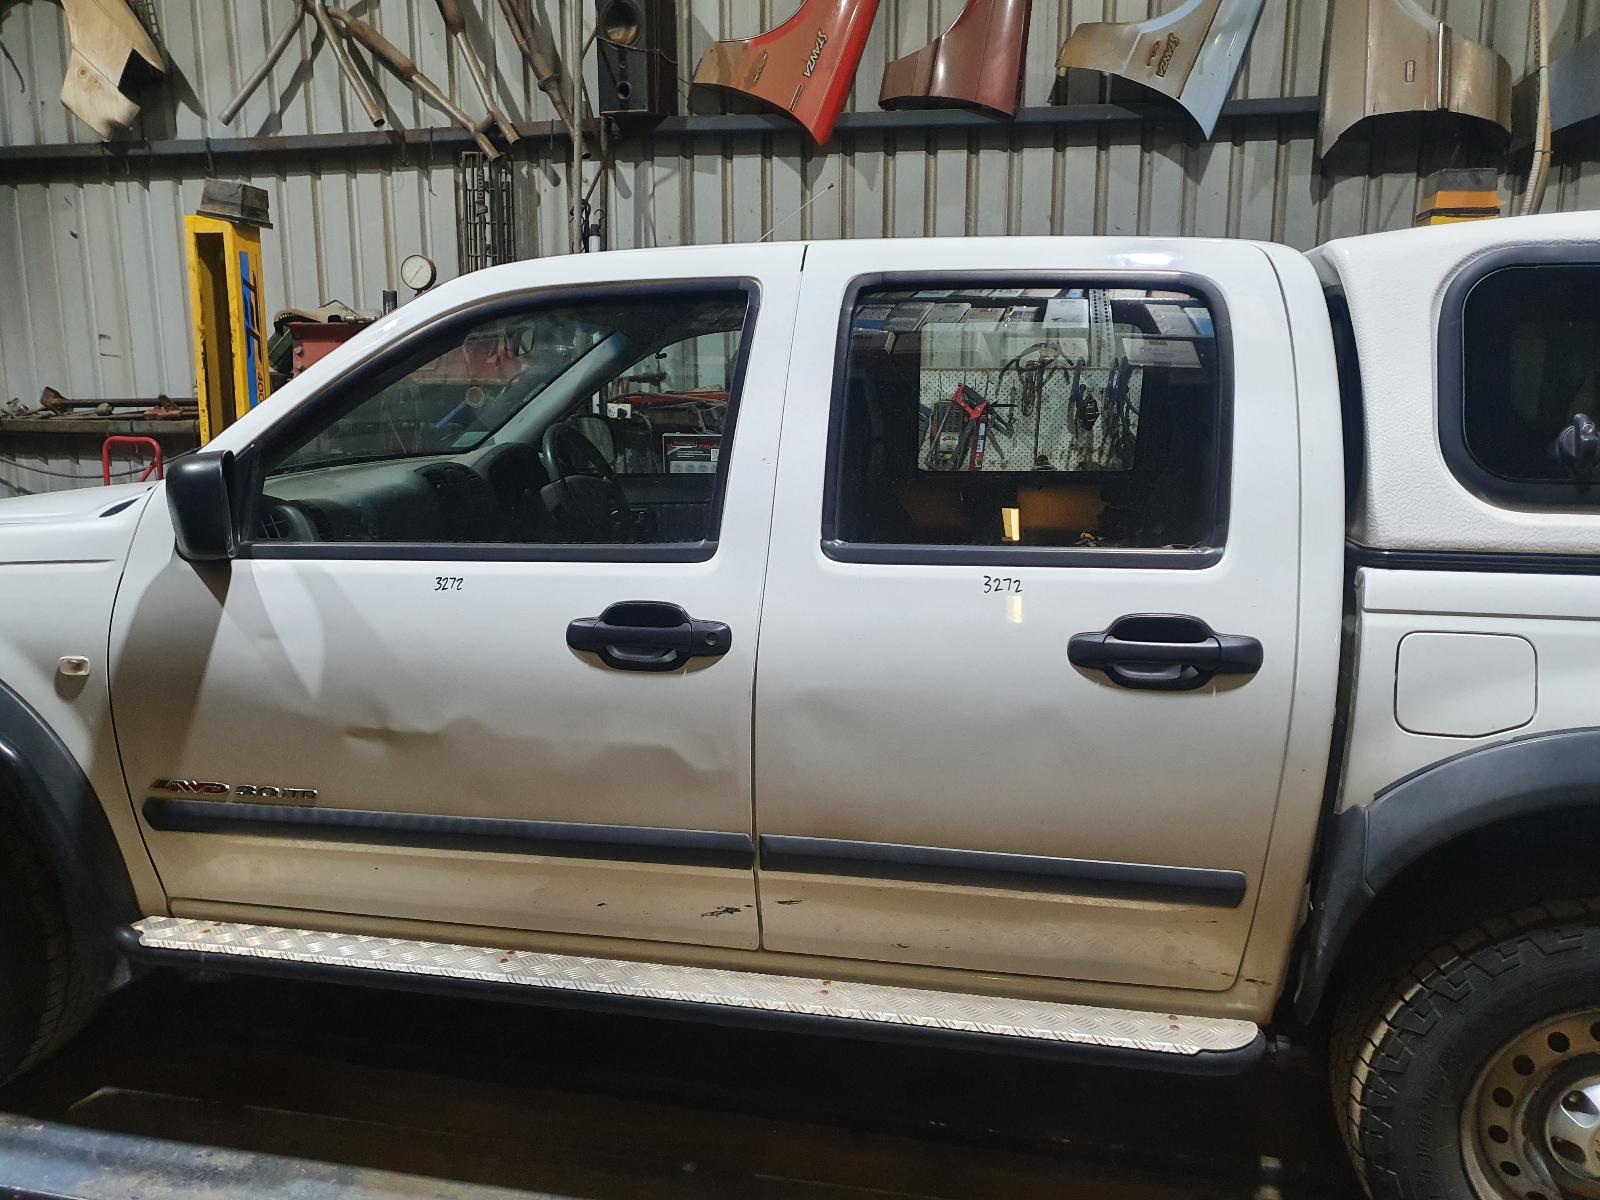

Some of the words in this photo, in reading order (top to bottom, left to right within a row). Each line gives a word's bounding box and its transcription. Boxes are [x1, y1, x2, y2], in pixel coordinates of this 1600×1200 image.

[803, 28, 828, 78] STANZA
[477, 168, 485, 202] TOYOTA
[434, 576, 464, 591] 3272
[983, 575, 1023, 593] 3272
